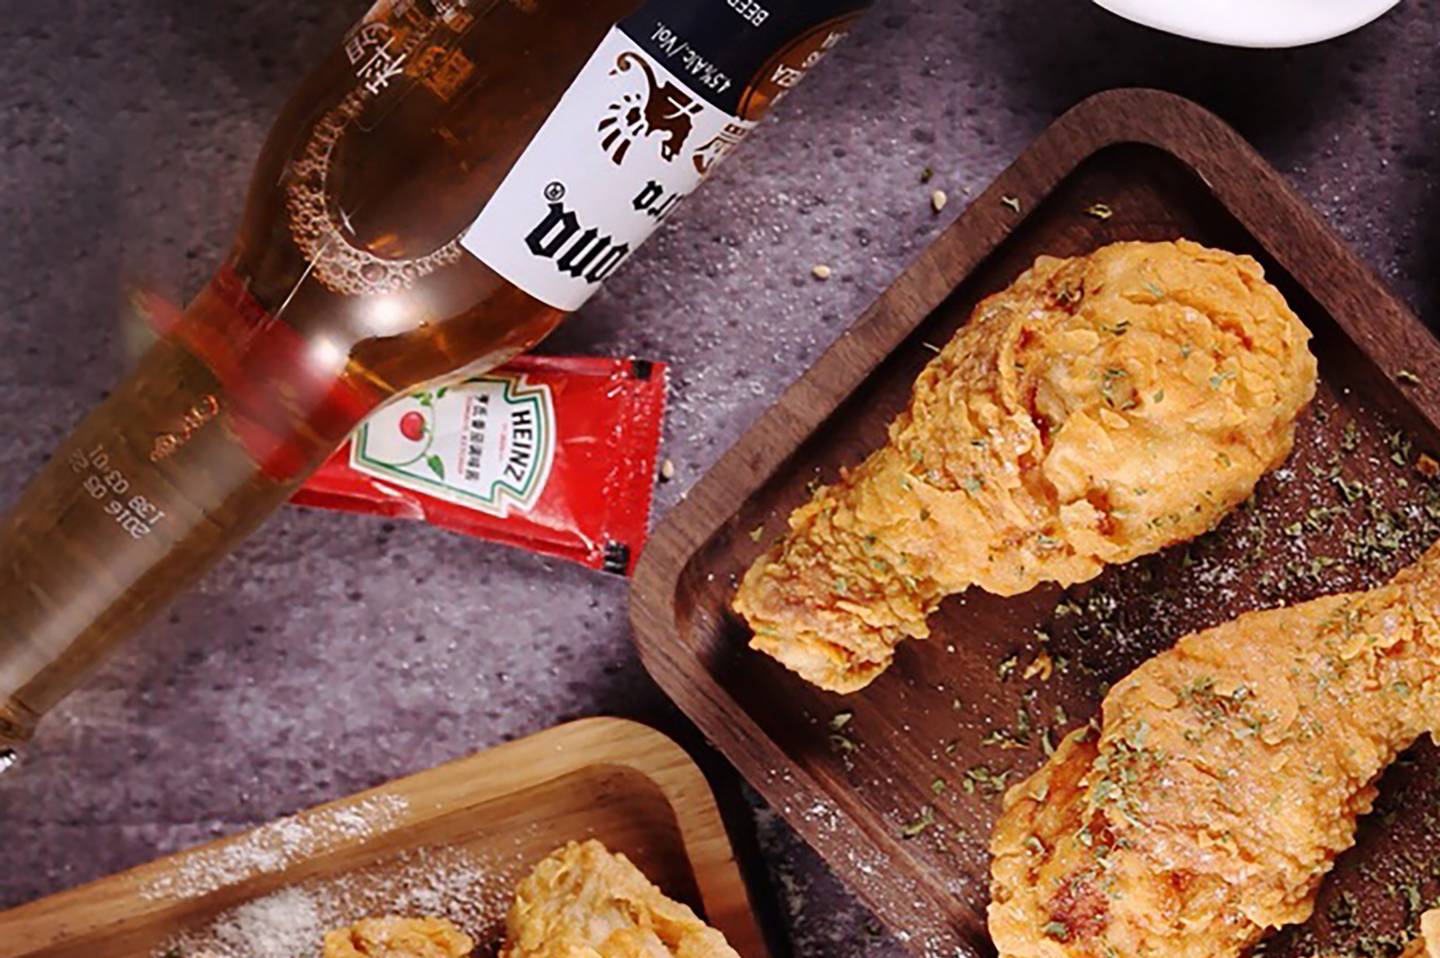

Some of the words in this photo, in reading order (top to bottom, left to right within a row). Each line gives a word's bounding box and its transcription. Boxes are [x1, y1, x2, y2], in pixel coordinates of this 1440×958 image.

[525, 203, 628, 284] ona
[504, 410, 532, 481] HEINZ
[83, 475, 107, 499] 05
[103, 499, 152, 539] 2016
